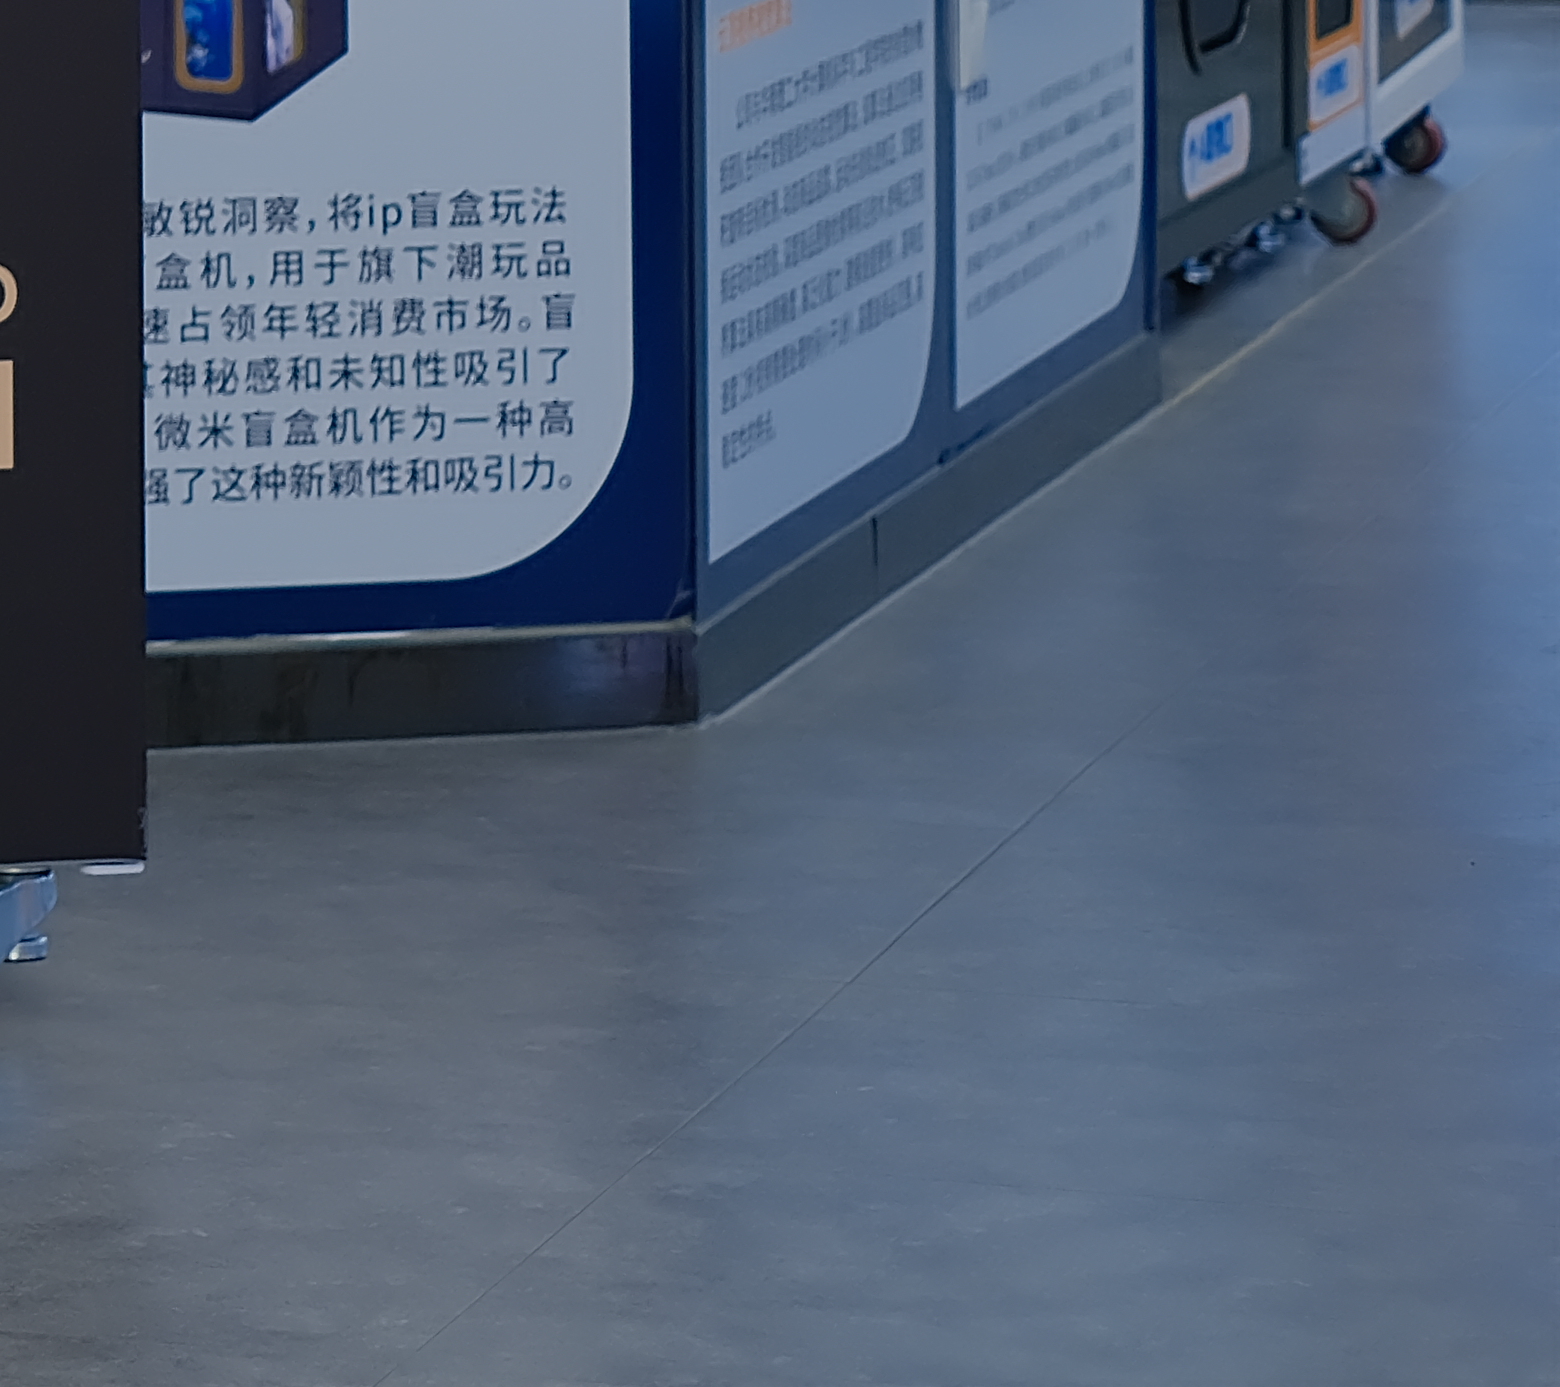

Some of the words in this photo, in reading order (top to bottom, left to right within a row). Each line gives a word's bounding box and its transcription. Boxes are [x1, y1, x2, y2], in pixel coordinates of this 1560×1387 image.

[154, 399, 574, 452] 微米盲盒机作为一种高
